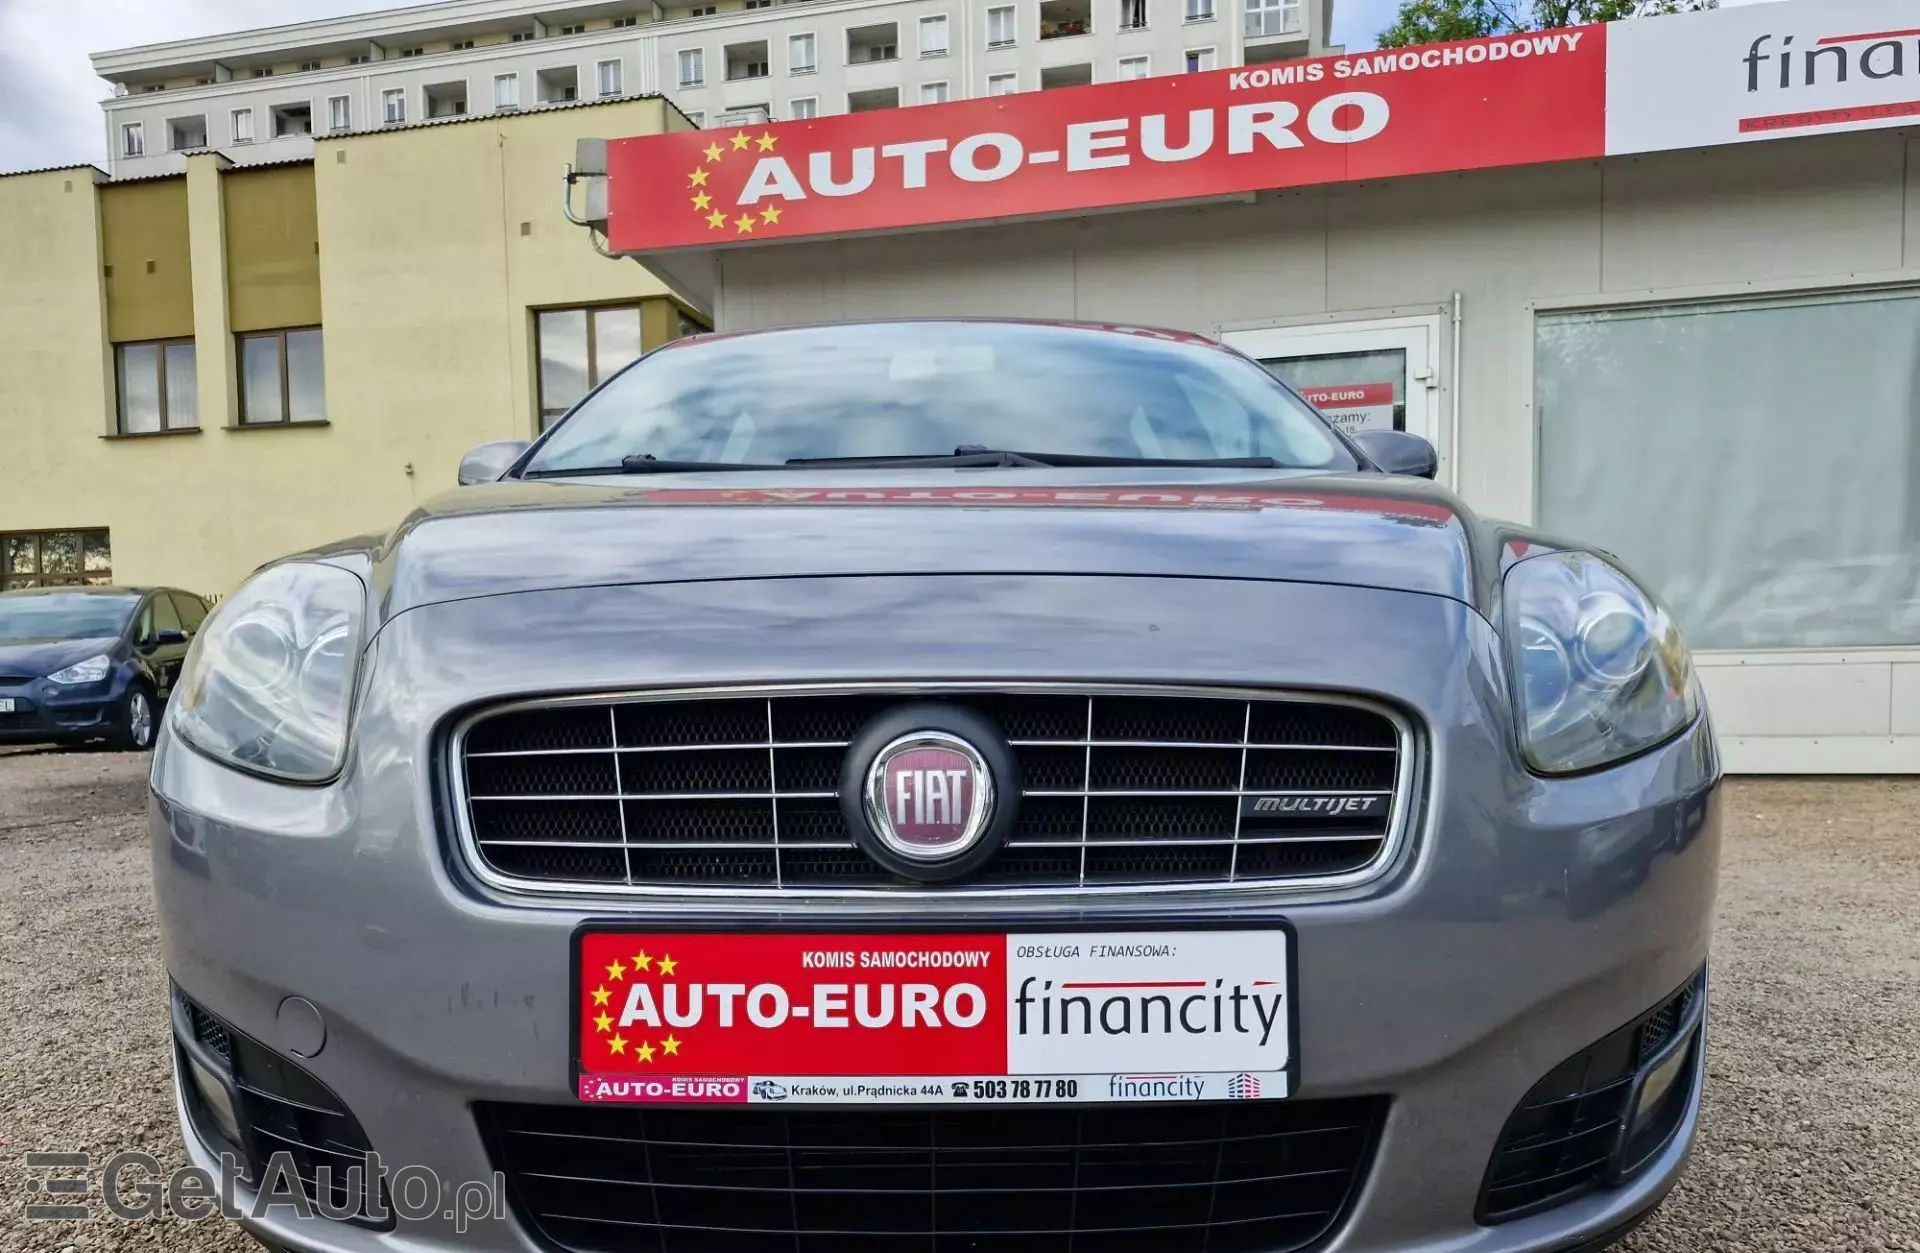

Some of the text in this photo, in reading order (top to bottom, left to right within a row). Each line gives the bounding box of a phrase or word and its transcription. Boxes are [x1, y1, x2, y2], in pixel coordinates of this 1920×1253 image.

[1229, 32, 1584, 91] KOMIS SAMOCHODOWY
[1742, 34, 1920, 92] fina
[736, 91, 1390, 205] AUTO-EURO
[896, 770, 967, 825] FIAT
[1254, 797, 1378, 816] MULTIJET
[802, 950, 990, 968] KOMIS SAMOCHODOWY
[1016, 944, 1177, 958] OBSŁUGA FINANSOWA:
[618, 982, 987, 1029] AUTO-EURO
[1014, 976, 1282, 1047] financity
[596, 1082, 740, 1097] AUTO-EURO
[791, 1083, 839, 1098] Kraków,
[920, 1084, 944, 1096] 44A
[974, 1080, 1007, 1099] 503
[1011, 1080, 1031, 1099] 78
[1034, 1080, 1052, 1098] 77
[1055, 1079, 1078, 1098] 80
[1109, 1075, 1205, 1100] financity
